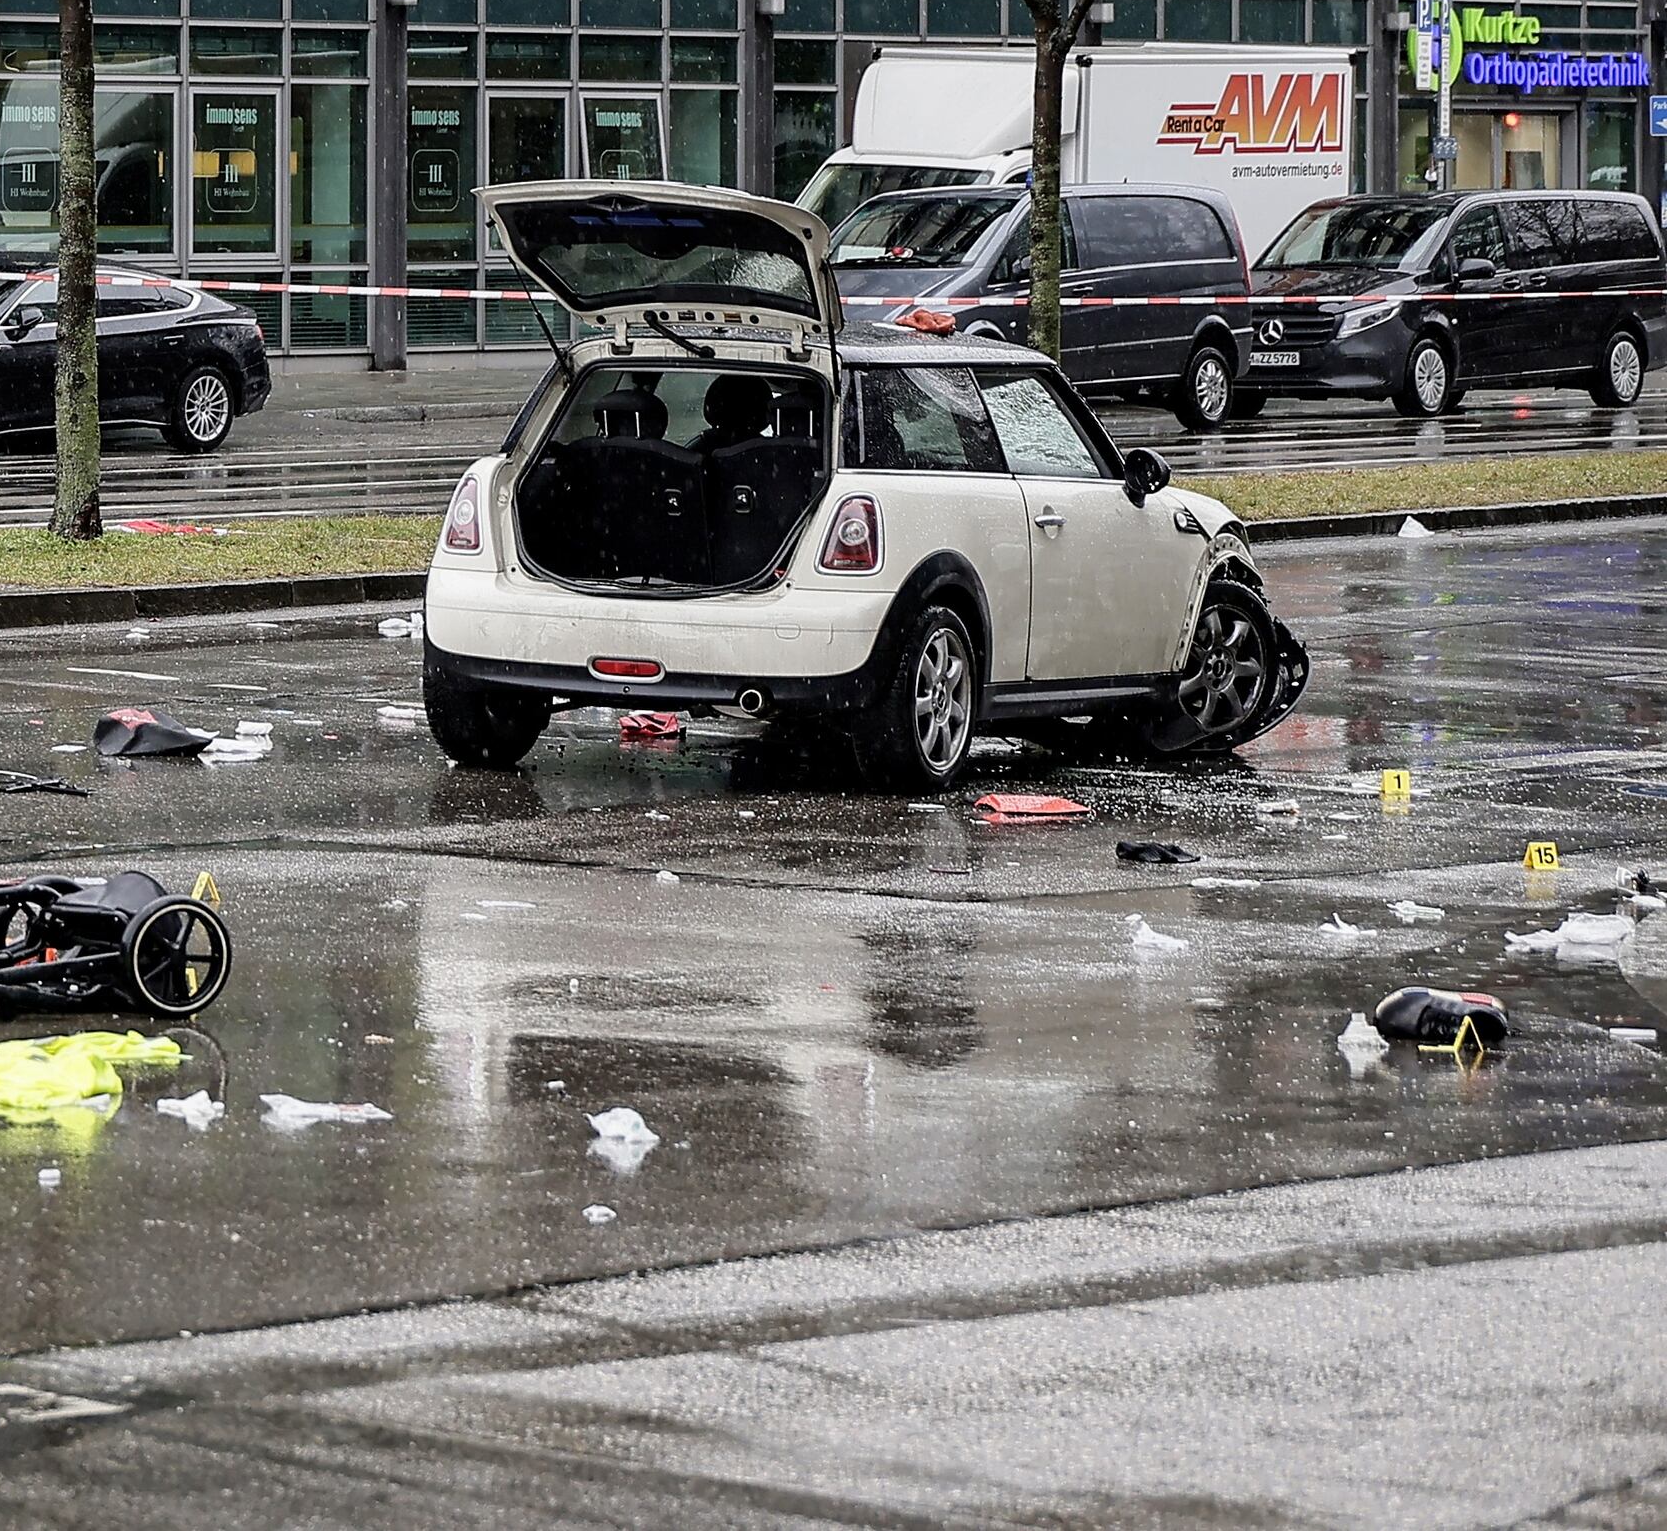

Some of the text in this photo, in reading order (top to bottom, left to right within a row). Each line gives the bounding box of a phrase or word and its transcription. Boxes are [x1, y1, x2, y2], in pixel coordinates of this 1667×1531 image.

[1463, 7, 1540, 45] Kurtze
[1466, 52, 1649, 95] Orthopädietechnik
[1203, 73, 1342, 146] AVM
[1167, 116, 1194, 133] Rent
[1203, 115, 1226, 133] Car
[1232, 162, 1343, 180] avm-autovermietung.de
[1273, 353, 1297, 364] 5778
[1393, 774, 1401, 789] 1
[1534, 847, 1555, 864] 15
